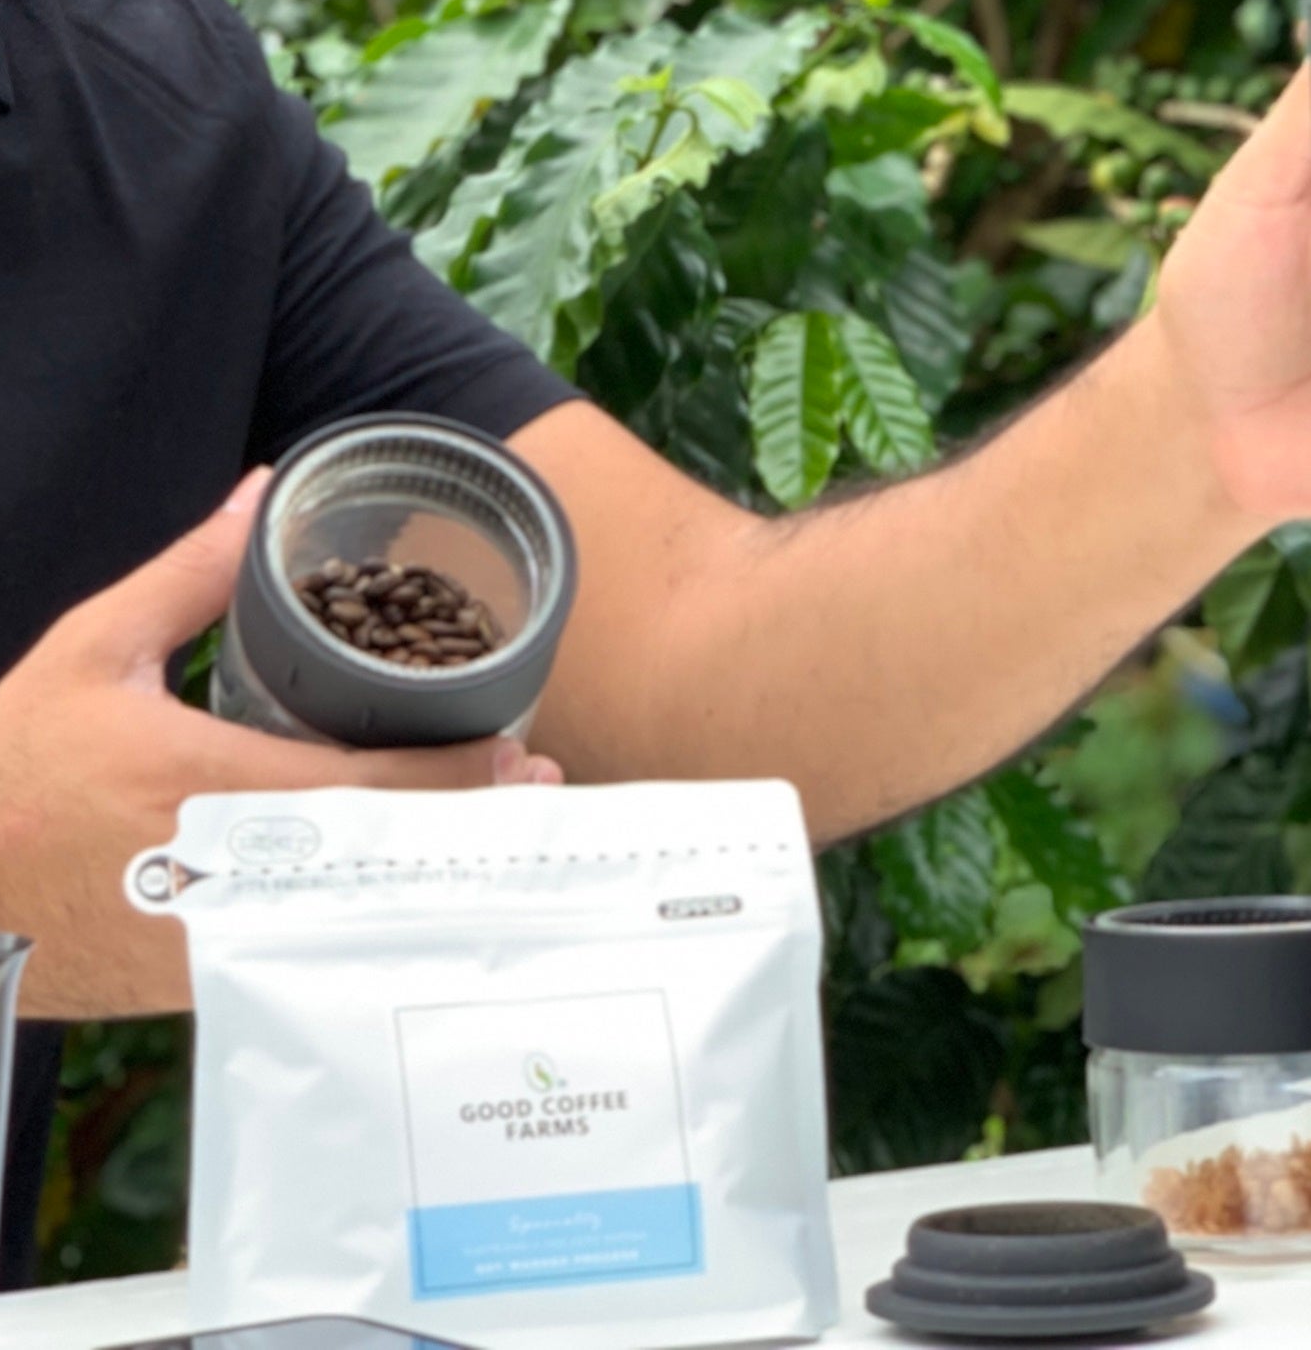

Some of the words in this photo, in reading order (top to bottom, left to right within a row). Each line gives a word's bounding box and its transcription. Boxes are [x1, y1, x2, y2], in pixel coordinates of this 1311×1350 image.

[661, 895, 739, 920] ZIPPER
[459, 1099, 533, 1123] GOOD
[540, 1090, 627, 1115] COFFEE
[505, 1116, 590, 1140] FARMS
